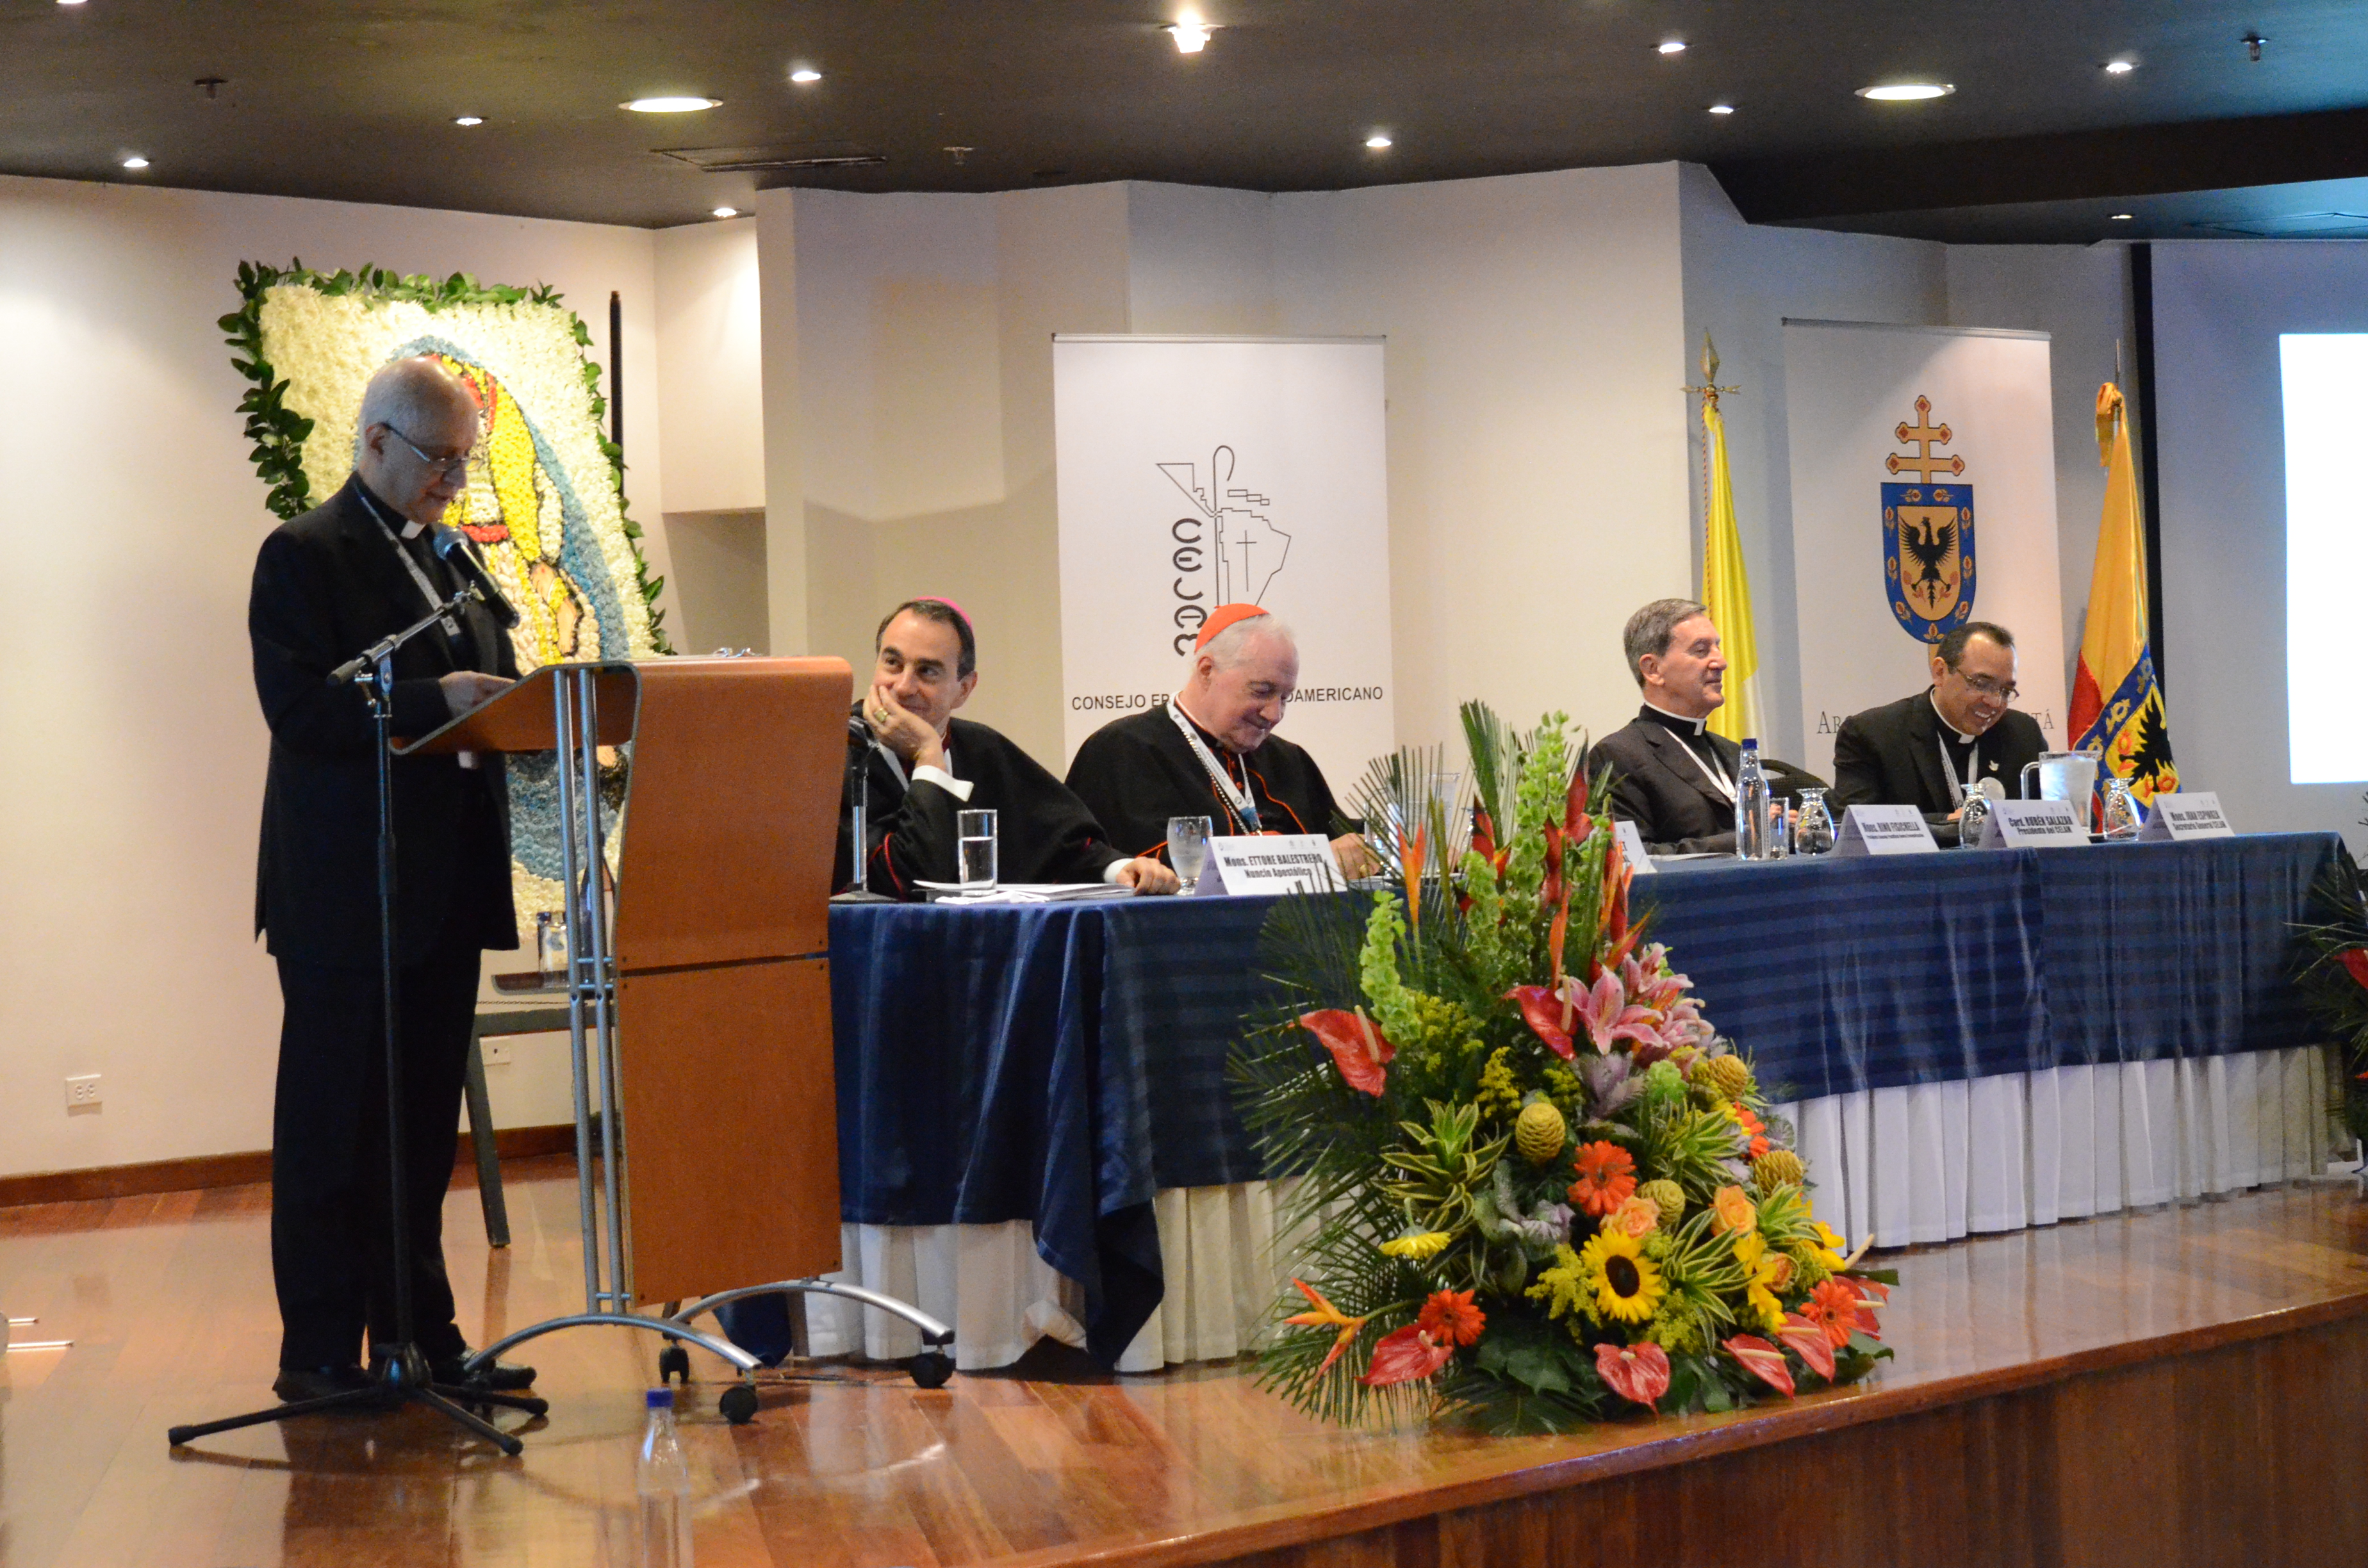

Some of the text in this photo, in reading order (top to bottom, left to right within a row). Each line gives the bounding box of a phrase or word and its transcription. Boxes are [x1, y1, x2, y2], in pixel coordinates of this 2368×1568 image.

[1072, 694, 1146, 710] CONSEJO
[2045, 815, 2073, 826] SALAZAR
[1223, 853, 1323, 867] Mons. ETTORE BALESTRERO
[1244, 867, 1312, 879] Nuncio Apostólico
